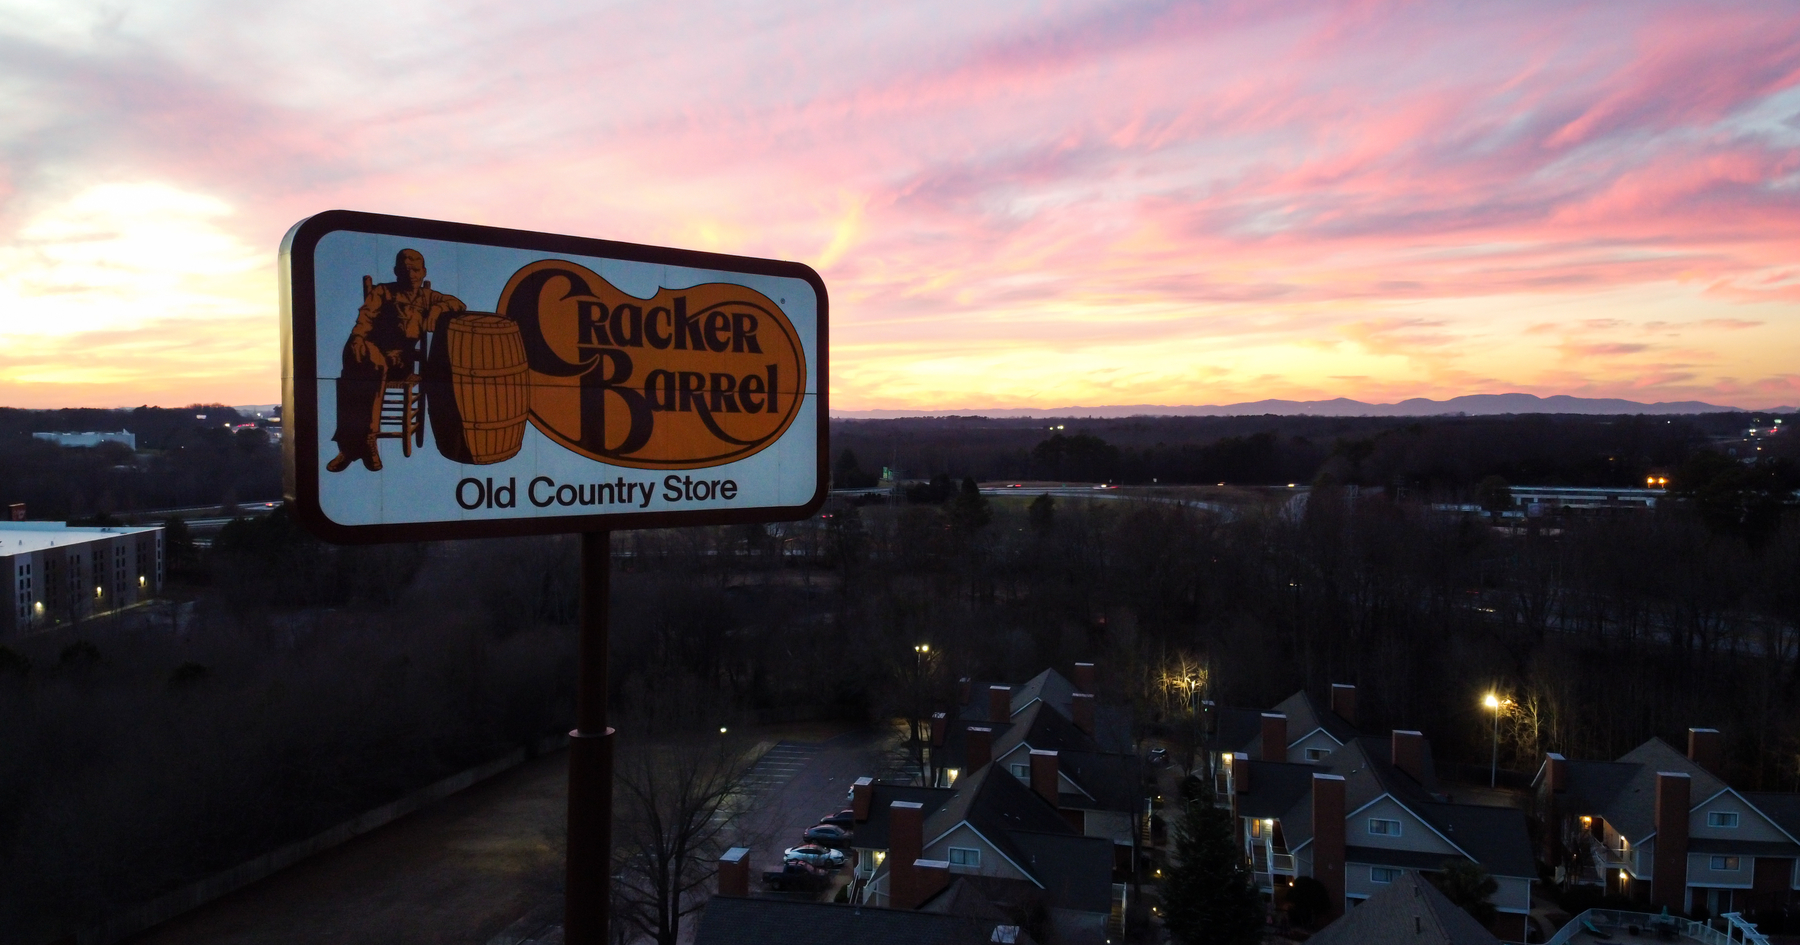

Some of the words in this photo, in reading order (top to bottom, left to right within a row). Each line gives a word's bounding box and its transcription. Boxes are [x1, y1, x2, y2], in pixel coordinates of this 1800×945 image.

[455, 477, 516, 510] Old
[528, 475, 656, 508] Country
[662, 474, 738, 502] Store
